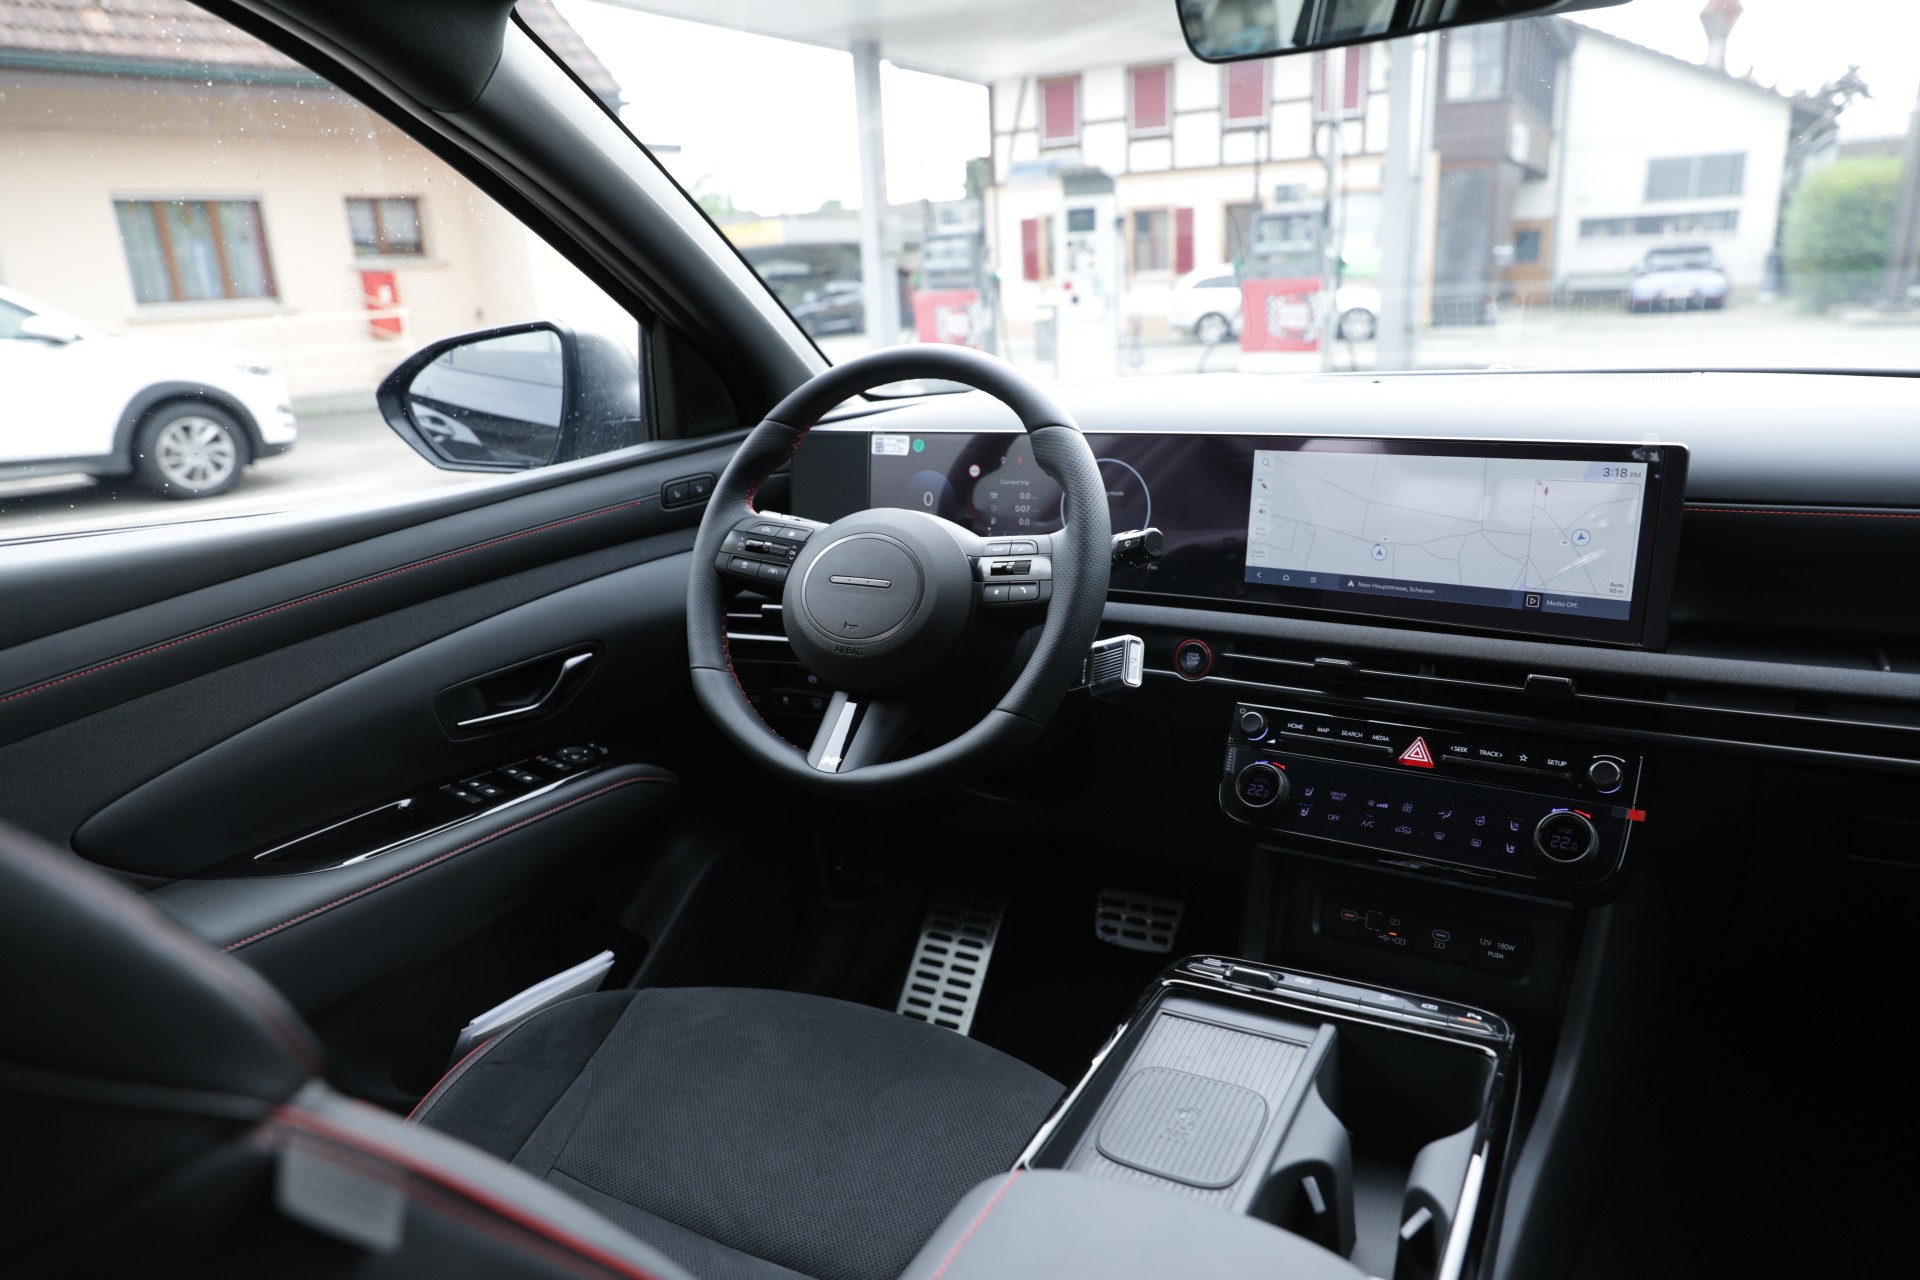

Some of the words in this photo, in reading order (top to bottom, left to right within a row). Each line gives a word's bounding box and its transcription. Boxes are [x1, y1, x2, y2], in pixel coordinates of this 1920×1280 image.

[1602, 467, 1628, 478] 3:18
[923, 491, 934, 507] 0
[1019, 492, 1031, 500] 0.0
[1014, 505, 1030, 513] 0:07
[1018, 518, 1030, 526] 0.0
[1371, 583, 1408, 592] Hauptstrasse,
[834, 645, 864, 656] AIRBAG
[1287, 722, 1304, 730] HOME
[1340, 730, 1363, 738] SEARCH
[1372, 734, 1390, 742] MEDIA
[1546, 758, 1568, 767] SETUP
[1247, 784, 1269, 798] 22.0
[1330, 790, 1347, 798] DRIVER
[1327, 813, 1341, 822] OFF
[1361, 820, 1375, 828] A/C
[1550, 835, 1578, 851] 22.0
[1479, 938, 1492, 946] 12V
[1497, 942, 1516, 952] 180W
[1487, 951, 1504, 960] PUSH
